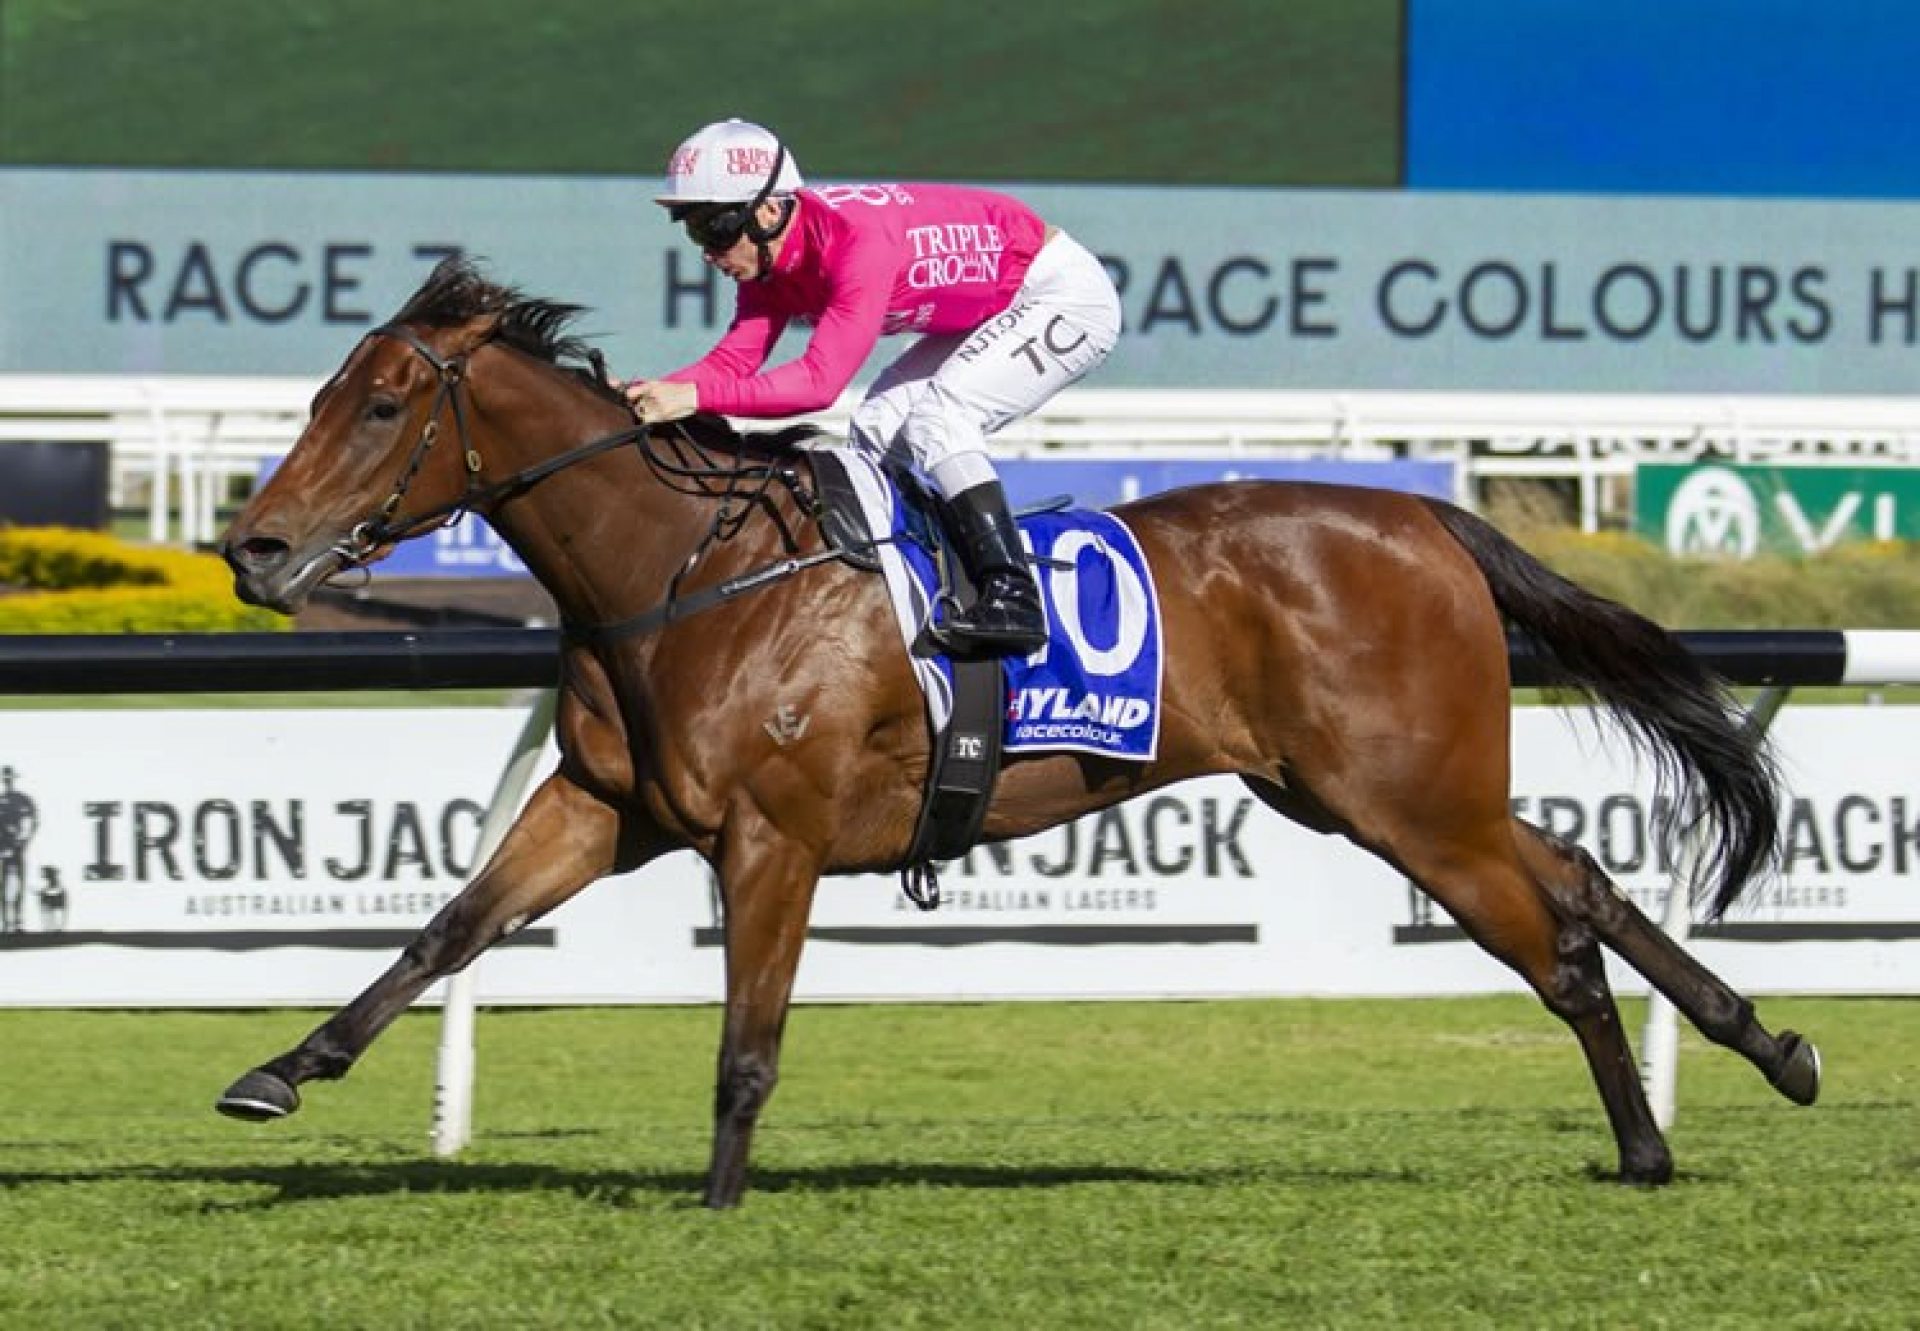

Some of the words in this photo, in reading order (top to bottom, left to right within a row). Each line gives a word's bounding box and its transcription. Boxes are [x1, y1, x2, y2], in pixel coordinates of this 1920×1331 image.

[906, 224, 1004, 258] TRIPLE
[106, 241, 372, 323] RACE
[1377, 260, 1832, 345] COLOURS
[1009, 314, 1089, 376] TC
[1021, 528, 1148, 677] 0
[959, 736, 982, 758] TC
[82, 798, 305, 882] IRON
[323, 797, 490, 882] JAC
[1030, 796, 1254, 878] JACK
[185, 894, 344, 917] AUSTRALIAN
[1064, 889, 1157, 910] LAGERS
